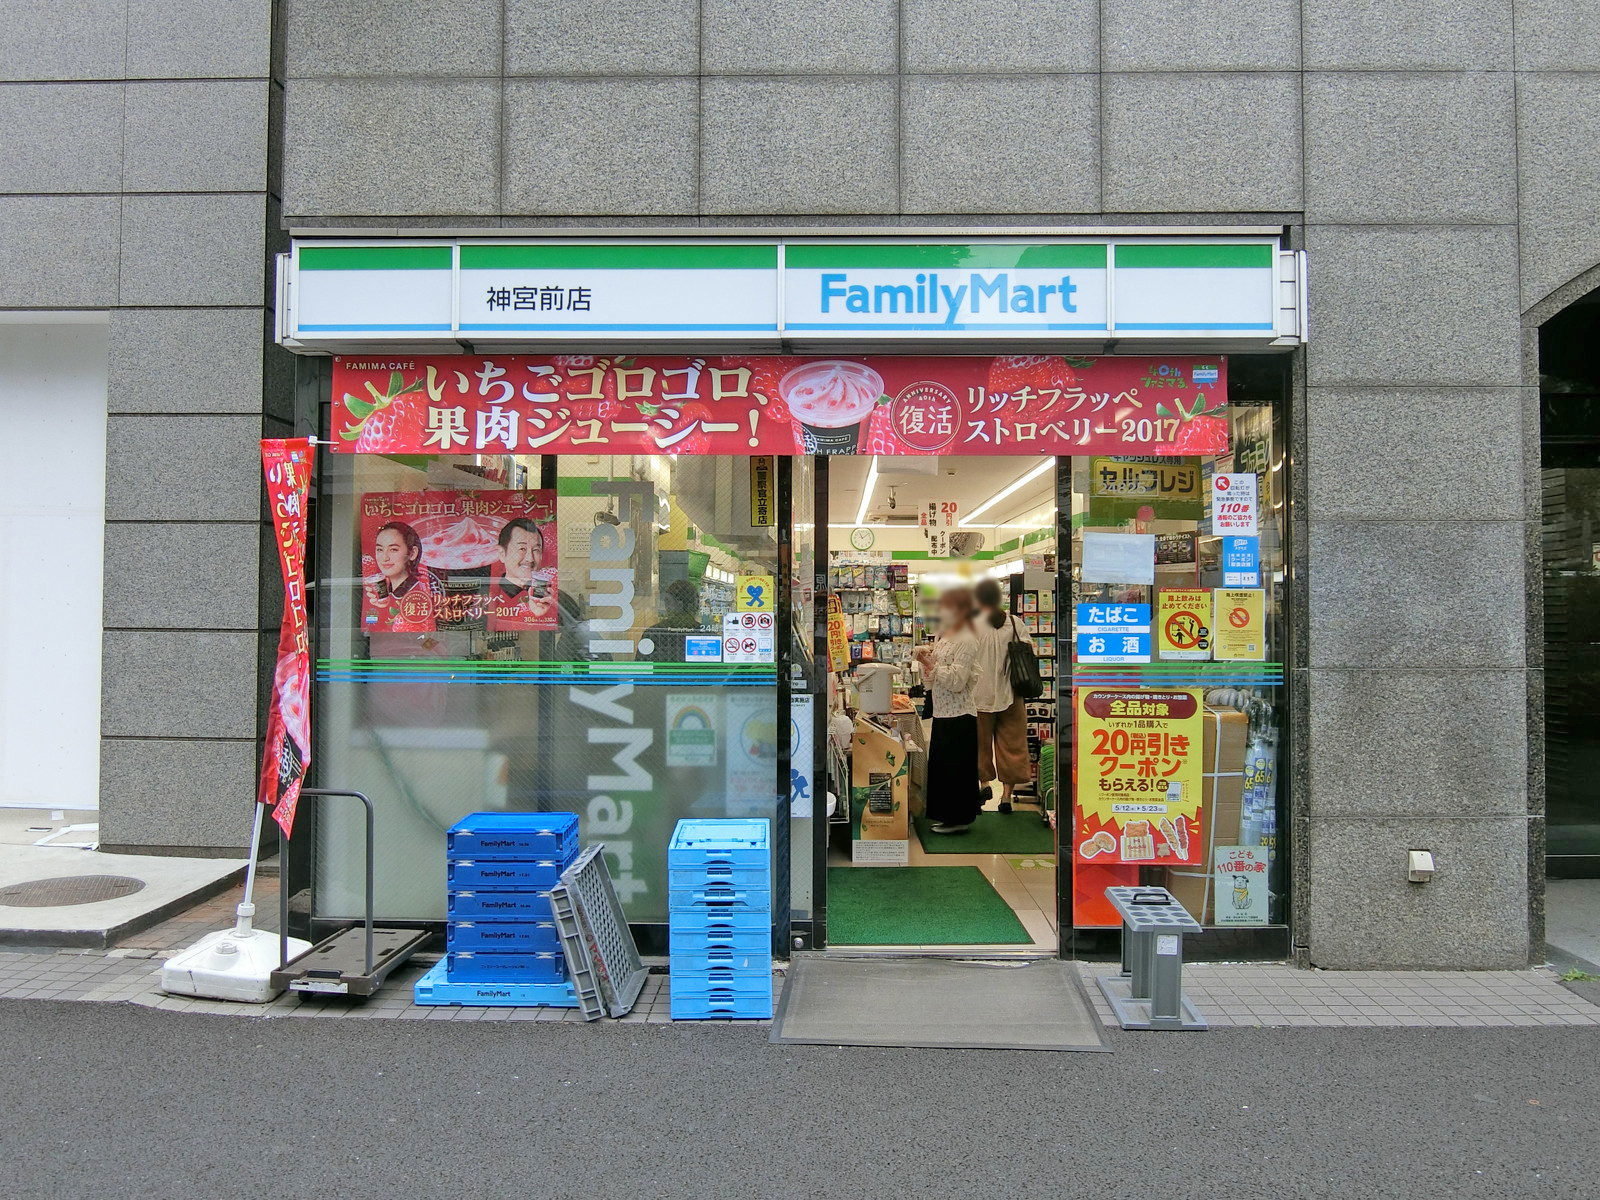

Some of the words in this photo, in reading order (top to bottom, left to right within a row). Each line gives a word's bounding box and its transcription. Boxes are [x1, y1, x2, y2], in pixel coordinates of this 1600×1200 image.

[486, 285, 592, 312] 神宮前店
[821, 273, 1077, 324] FamilyMart
[345, 362, 387, 371] FAMIMA
[388, 359, 416, 371] CAFÉ
[424, 359, 769, 405] いちごゴロゴロ、
[903, 388, 951, 403] ANNIVERSARY
[966, 386, 1143, 414] リッチフラッペ
[899, 405, 953, 435] 復活
[966, 417, 1180, 445] ストロベリー2017
[1099, 466, 1195, 493] セルフレジ
[941, 501, 958, 513] 20
[1220, 503, 1250, 513] 110番
[432, 594, 506, 606] リッチフラッペ
[1167, 594, 1202, 602] 路上飲みは
[403, 601, 429, 617] 復活
[432, 606, 521, 620] ストロベリー2017
[1088, 606, 1139, 624] たばこ
[1109, 700, 1170, 717] 全品対象
[1108, 720, 1169, 729] いずれか1品購入で
[1090, 728, 1191, 757] 20円引き
[1098, 777, 1154, 792] もらえる!
[480, 840, 516, 849] FamilyMart
[1229, 850, 1255, 860] こども
[1217, 860, 1267, 874] 110番の家
[480, 870, 516, 879] FamilyMart
[481, 901, 517, 910] FamilyMart
[480, 932, 516, 940] FamilyMart
[476, 990, 511, 999] FamilyMart
